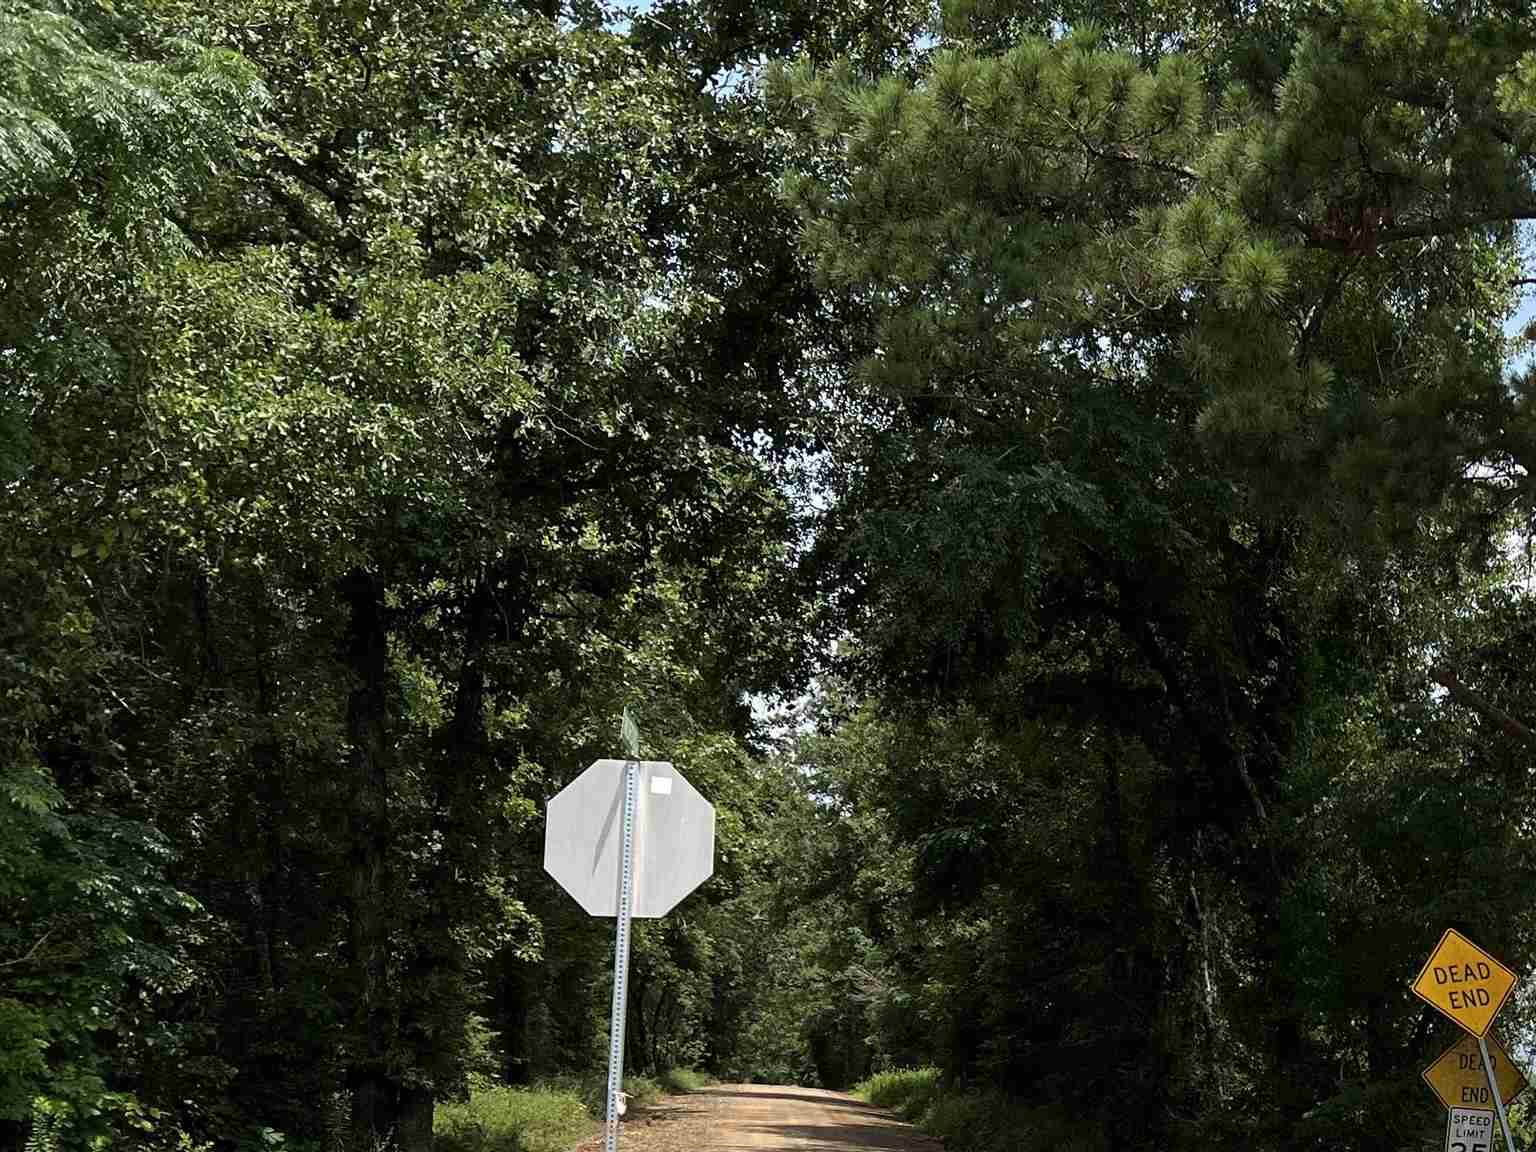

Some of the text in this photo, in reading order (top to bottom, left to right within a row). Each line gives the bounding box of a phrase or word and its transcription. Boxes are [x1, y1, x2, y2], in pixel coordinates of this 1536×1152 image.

[1433, 962, 1490, 984] DEAD
[1448, 988, 1490, 1009] END
[1461, 1087, 1489, 1103] END
[1453, 1114, 1491, 1126] SPEED
[1456, 1128, 1485, 1138] LIMIT
